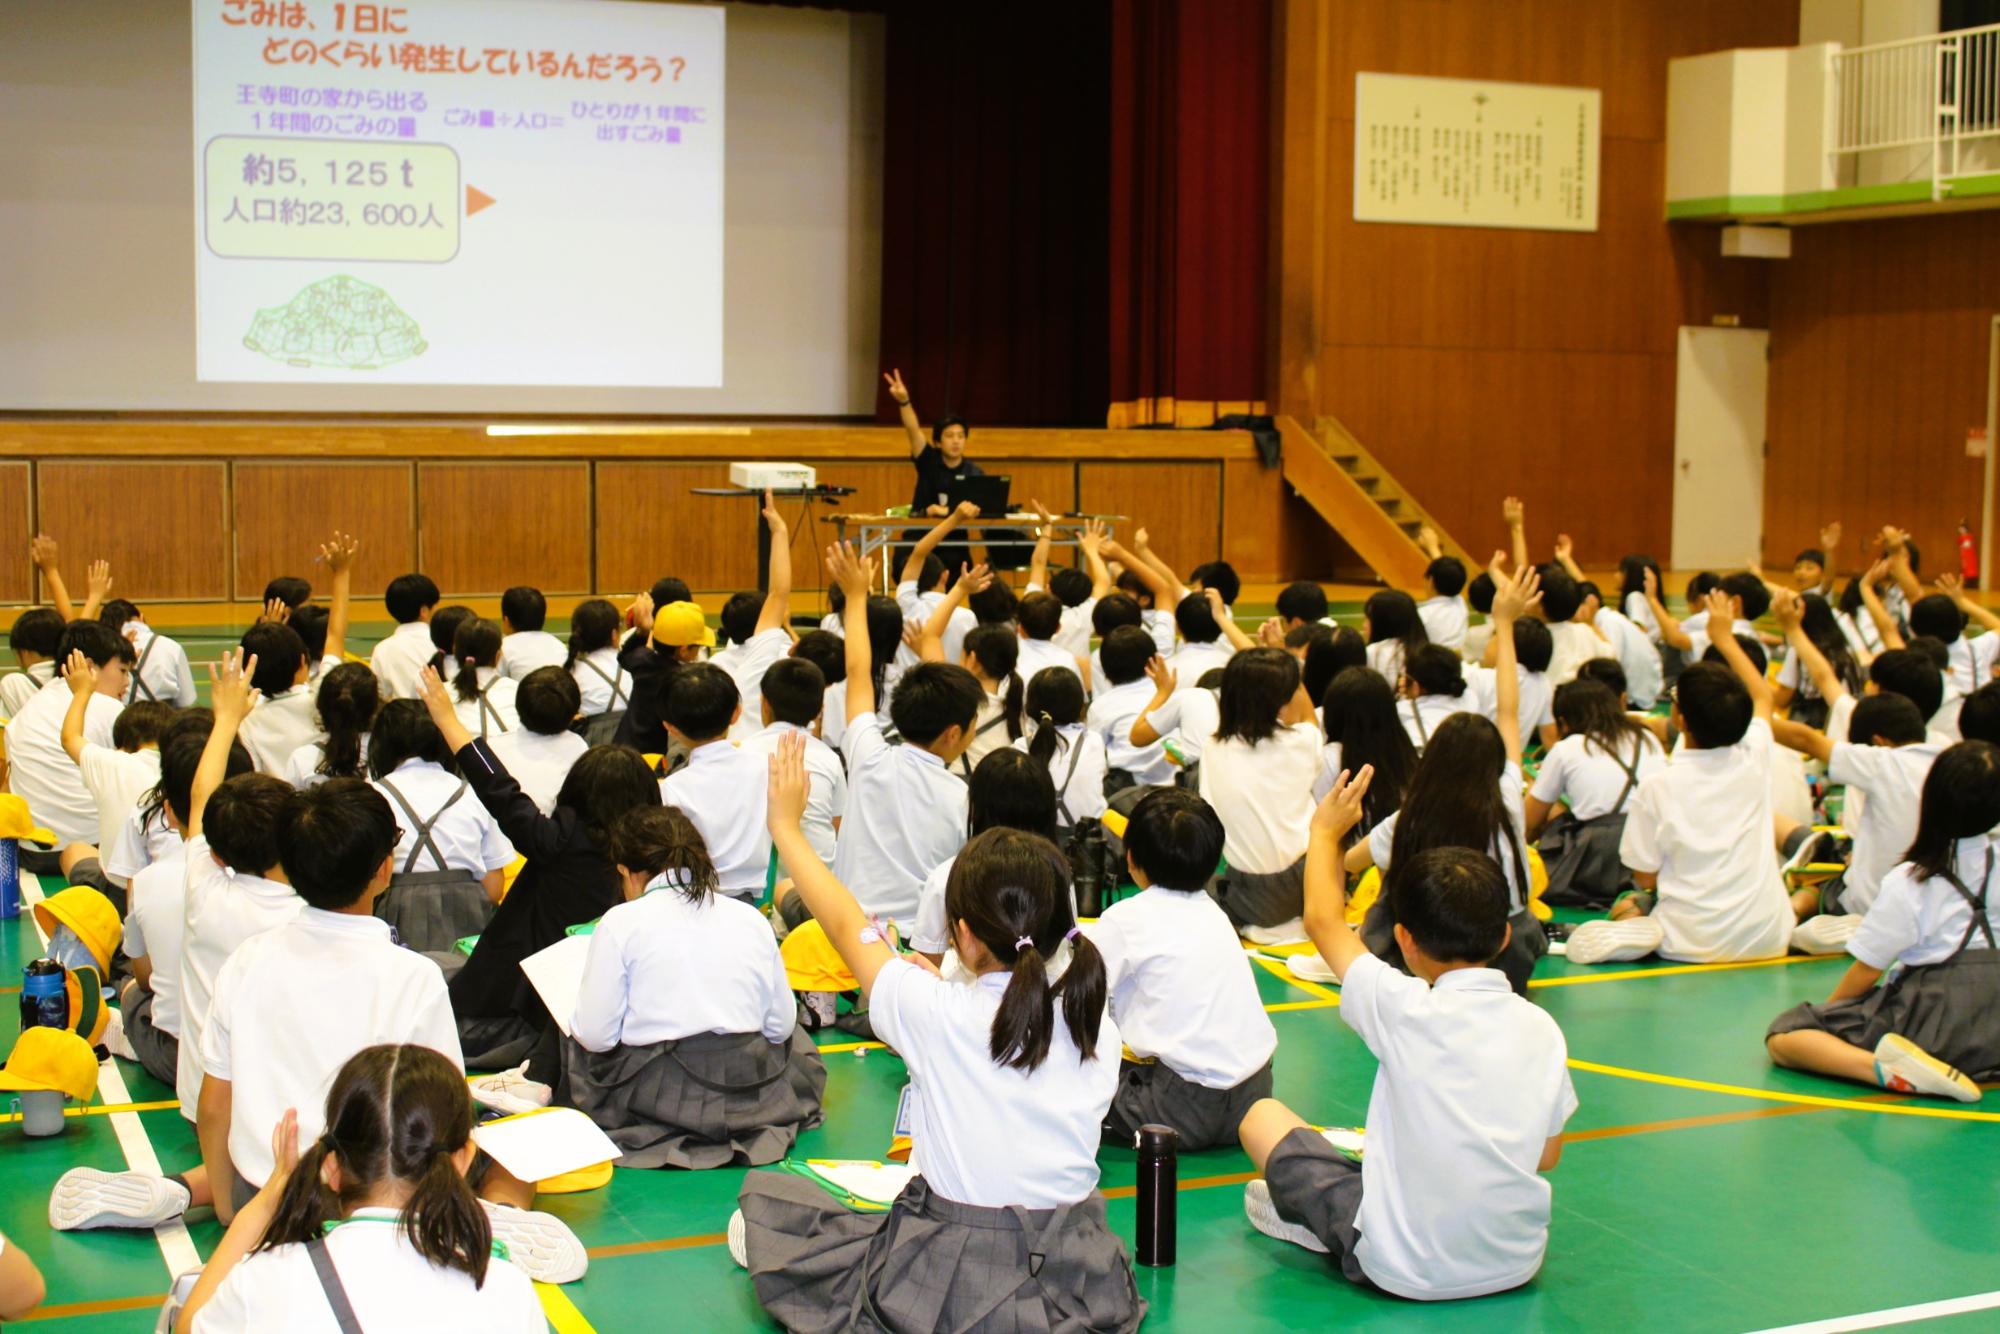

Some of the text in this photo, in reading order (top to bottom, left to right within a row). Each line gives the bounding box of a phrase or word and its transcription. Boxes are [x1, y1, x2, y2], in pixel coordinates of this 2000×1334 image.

[237, 84, 428, 112] 王寺町の家から出る
